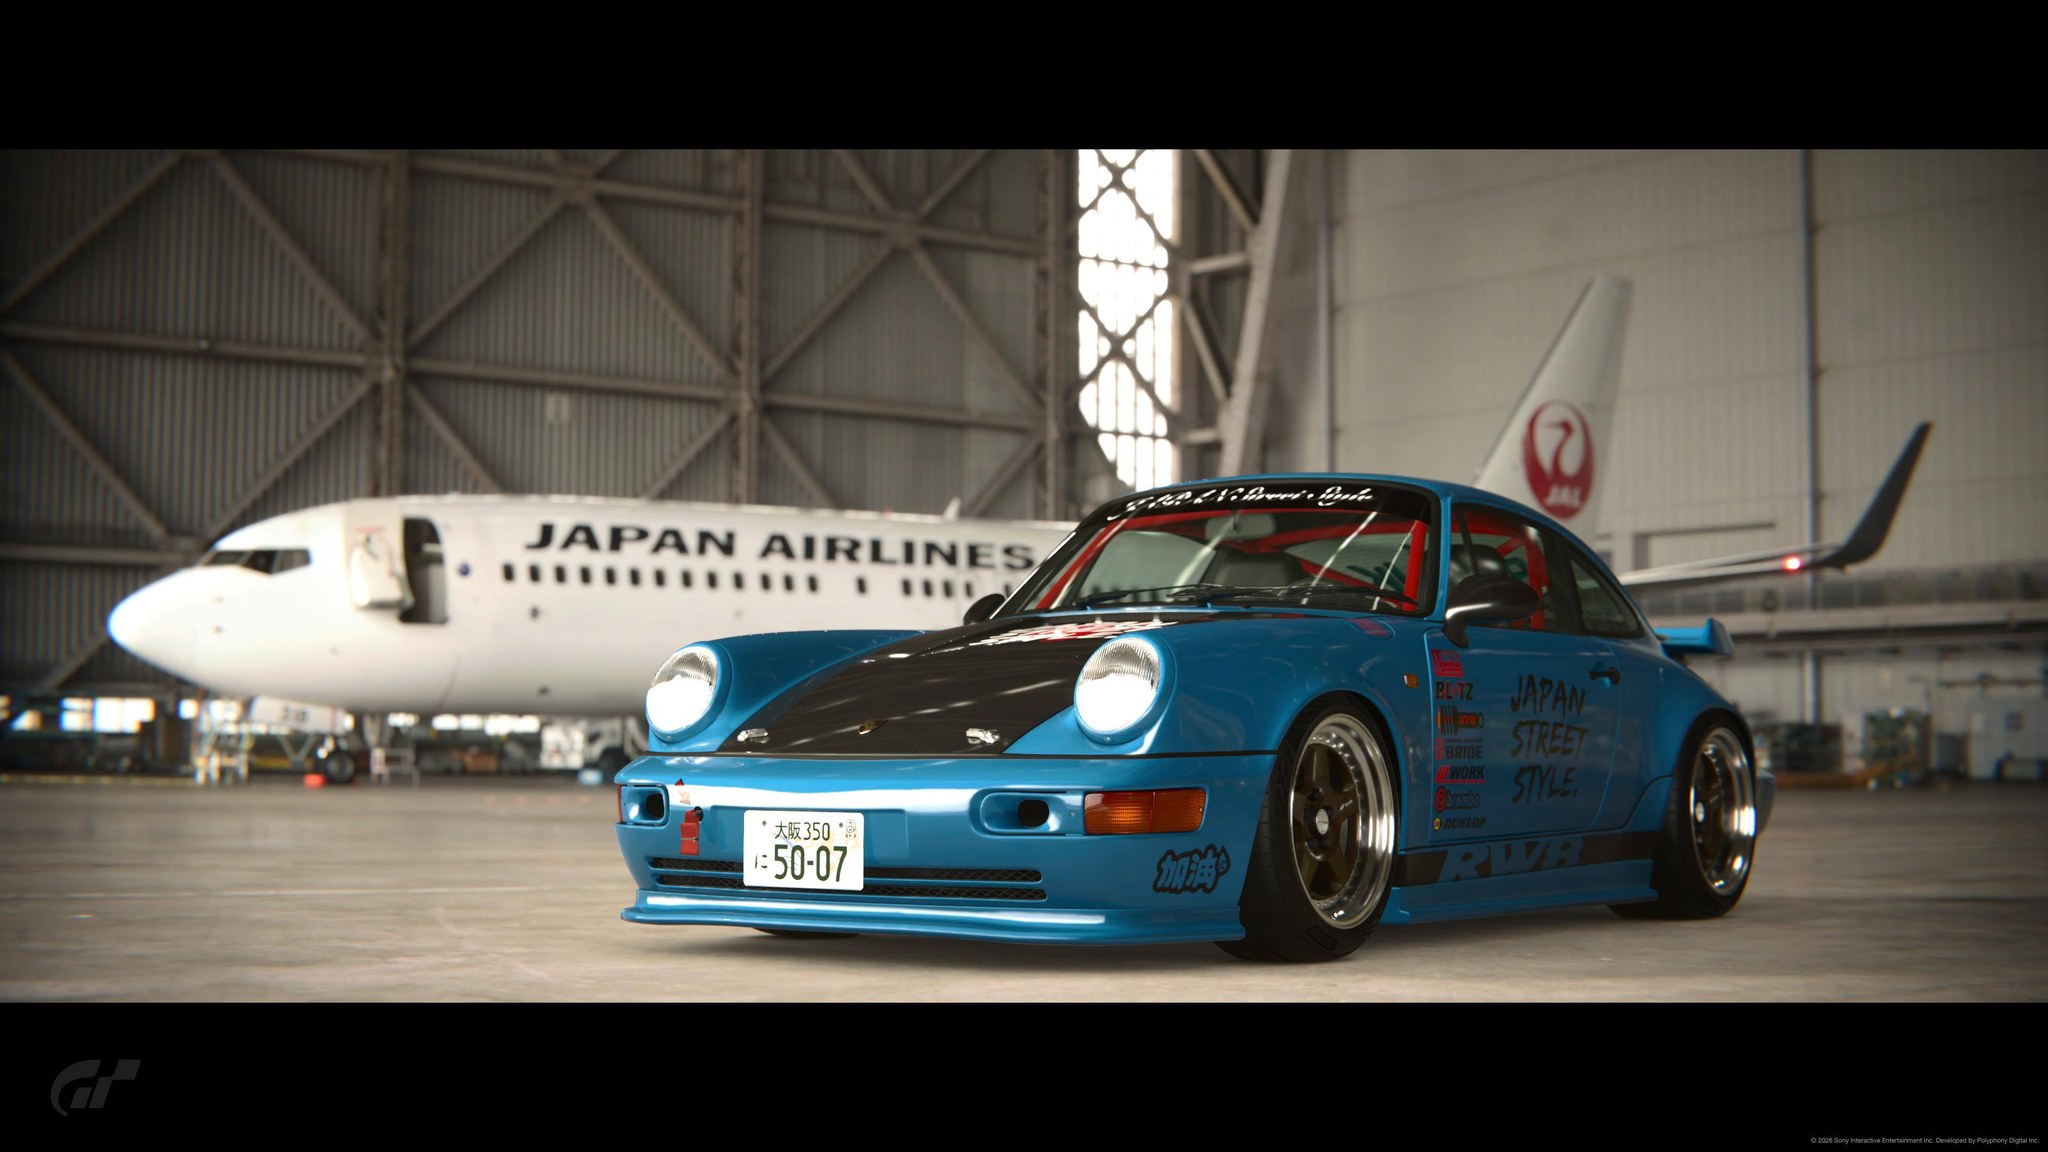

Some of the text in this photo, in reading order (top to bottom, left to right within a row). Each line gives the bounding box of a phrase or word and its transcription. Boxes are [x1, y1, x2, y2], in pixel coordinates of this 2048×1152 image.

[1545, 484, 1580, 506] JAL
[525, 522, 1036, 570] JAPAN AIRLINES
[1436, 681, 1474, 700] BLITZ
[1511, 674, 1586, 717] JAPAN
[1511, 720, 1590, 760] STREET
[1445, 745, 1482, 760] BRIDE
[1450, 765, 1485, 780] WORK
[775, 821, 801, 840] 大阪
[803, 822, 830, 841] 350
[1443, 817, 1487, 829] DUNLOP
[774, 844, 848, 882] 50-07
[1437, 836, 1586, 883] RWB
